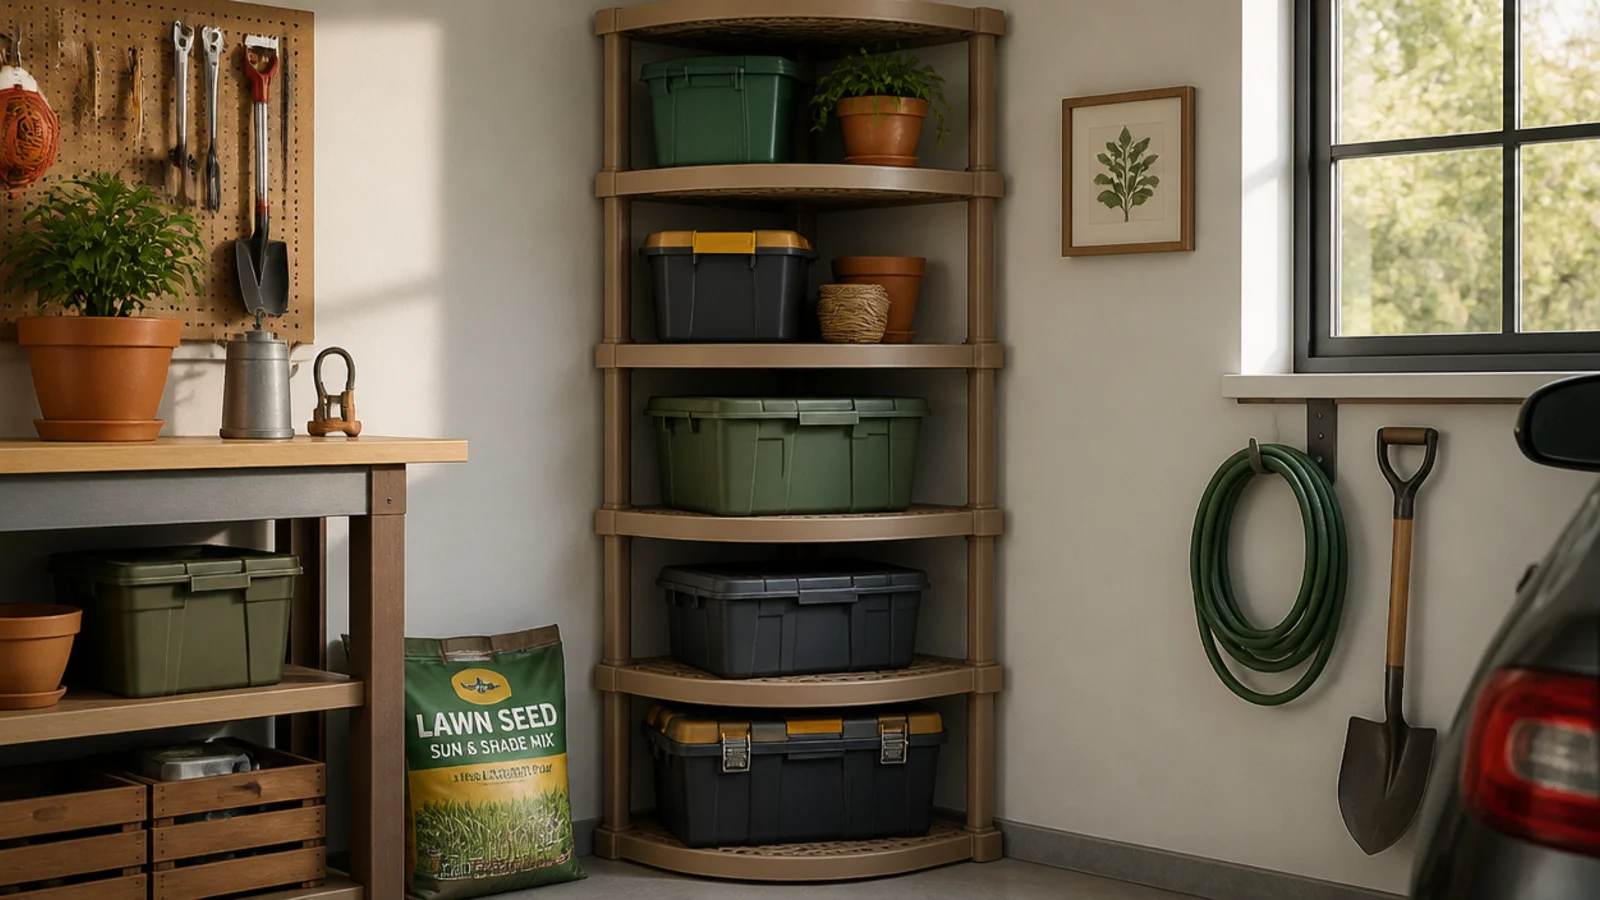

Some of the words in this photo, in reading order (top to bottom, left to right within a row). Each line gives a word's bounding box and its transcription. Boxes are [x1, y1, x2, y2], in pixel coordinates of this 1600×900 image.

[416, 711, 493, 738] LAWN
[498, 703, 557, 732] SEED
[430, 742, 463, 759] SUN
[467, 741, 477, 755] &
[482, 736, 528, 754] SHADE
[530, 733, 555, 749] MIX
